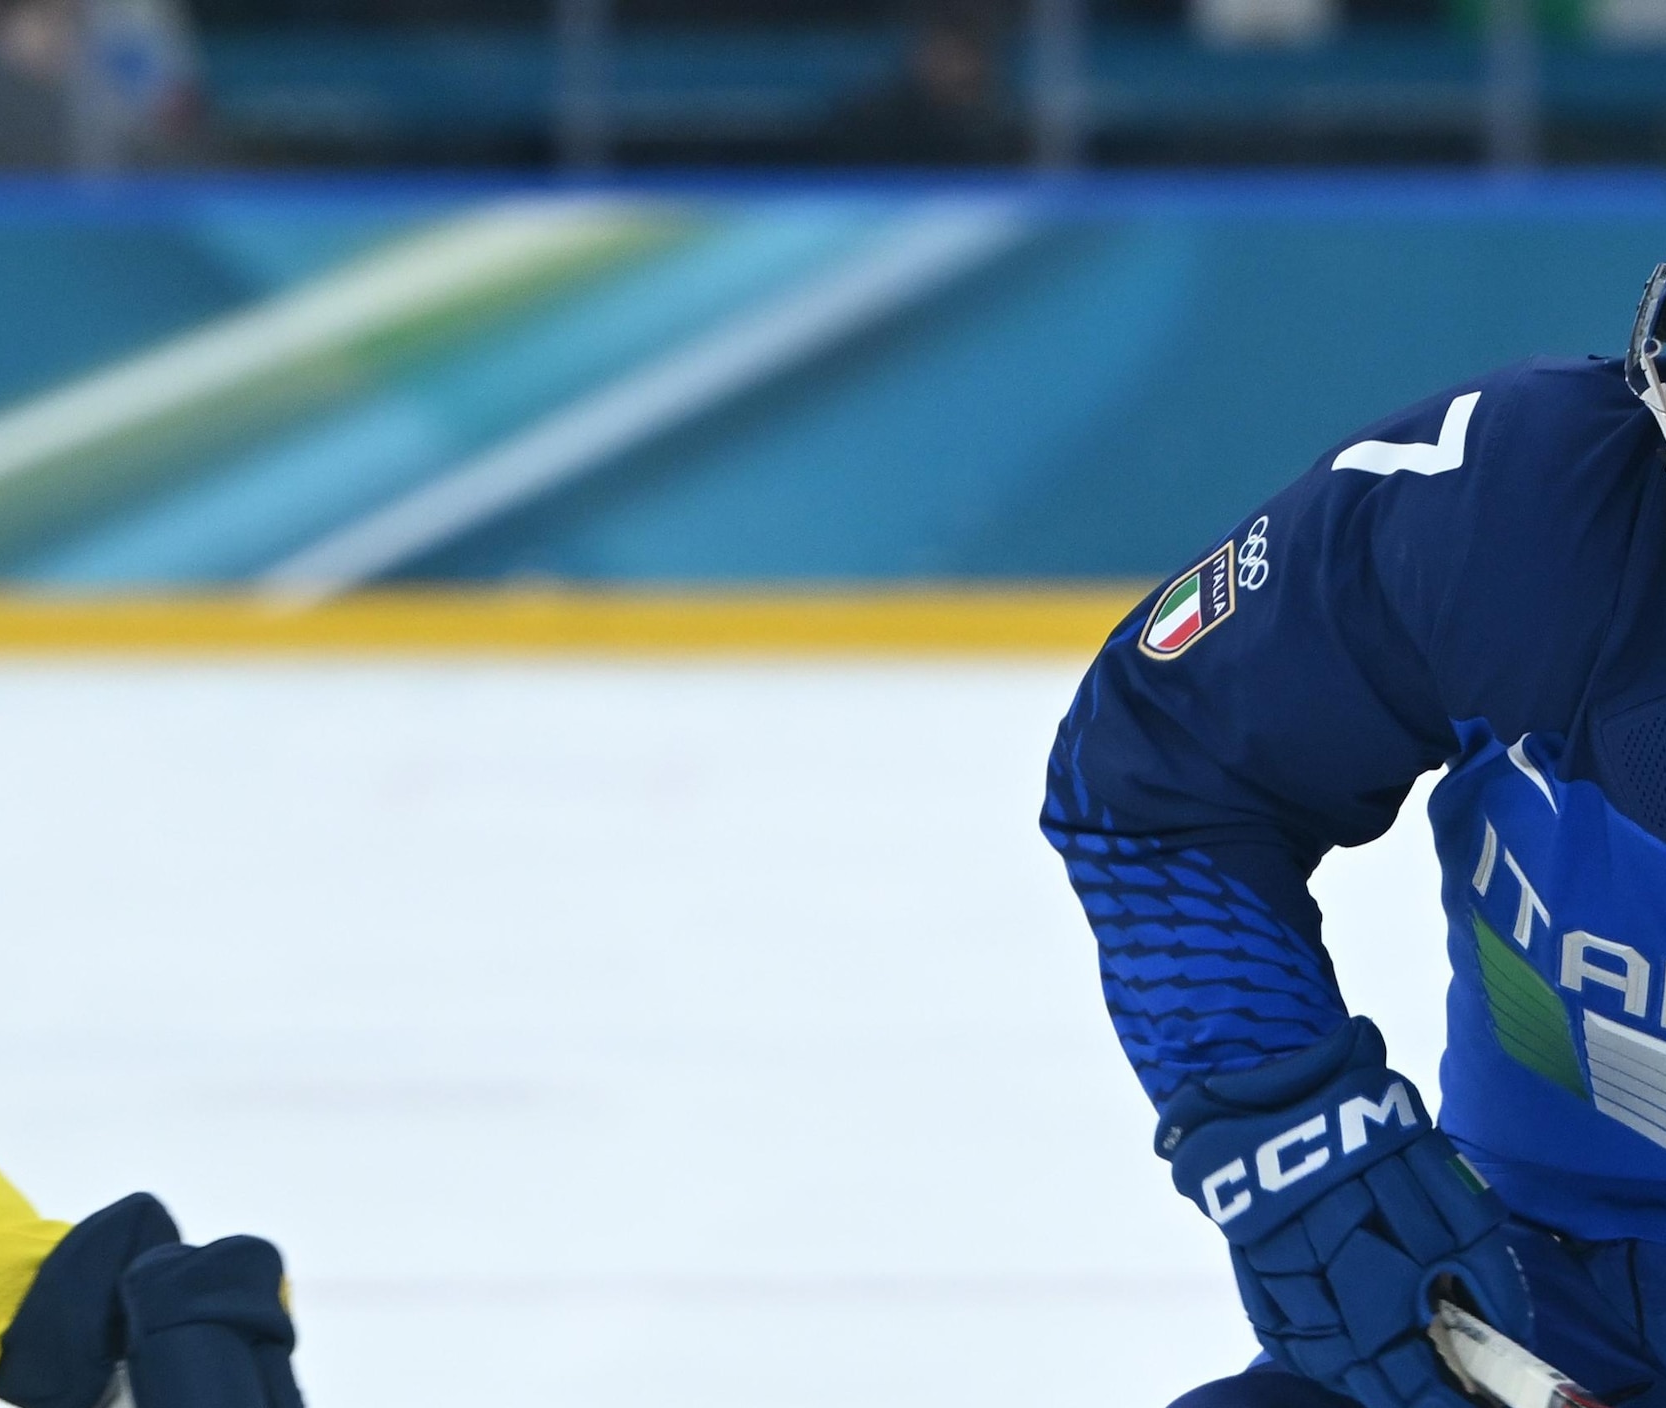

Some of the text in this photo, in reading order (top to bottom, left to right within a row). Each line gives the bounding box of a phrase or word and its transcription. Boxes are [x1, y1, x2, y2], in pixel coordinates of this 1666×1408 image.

[1331, 390, 1483, 476] 7
[1212, 553, 1227, 618] ITALIA
[1200, 1081, 1418, 1226] CCM
